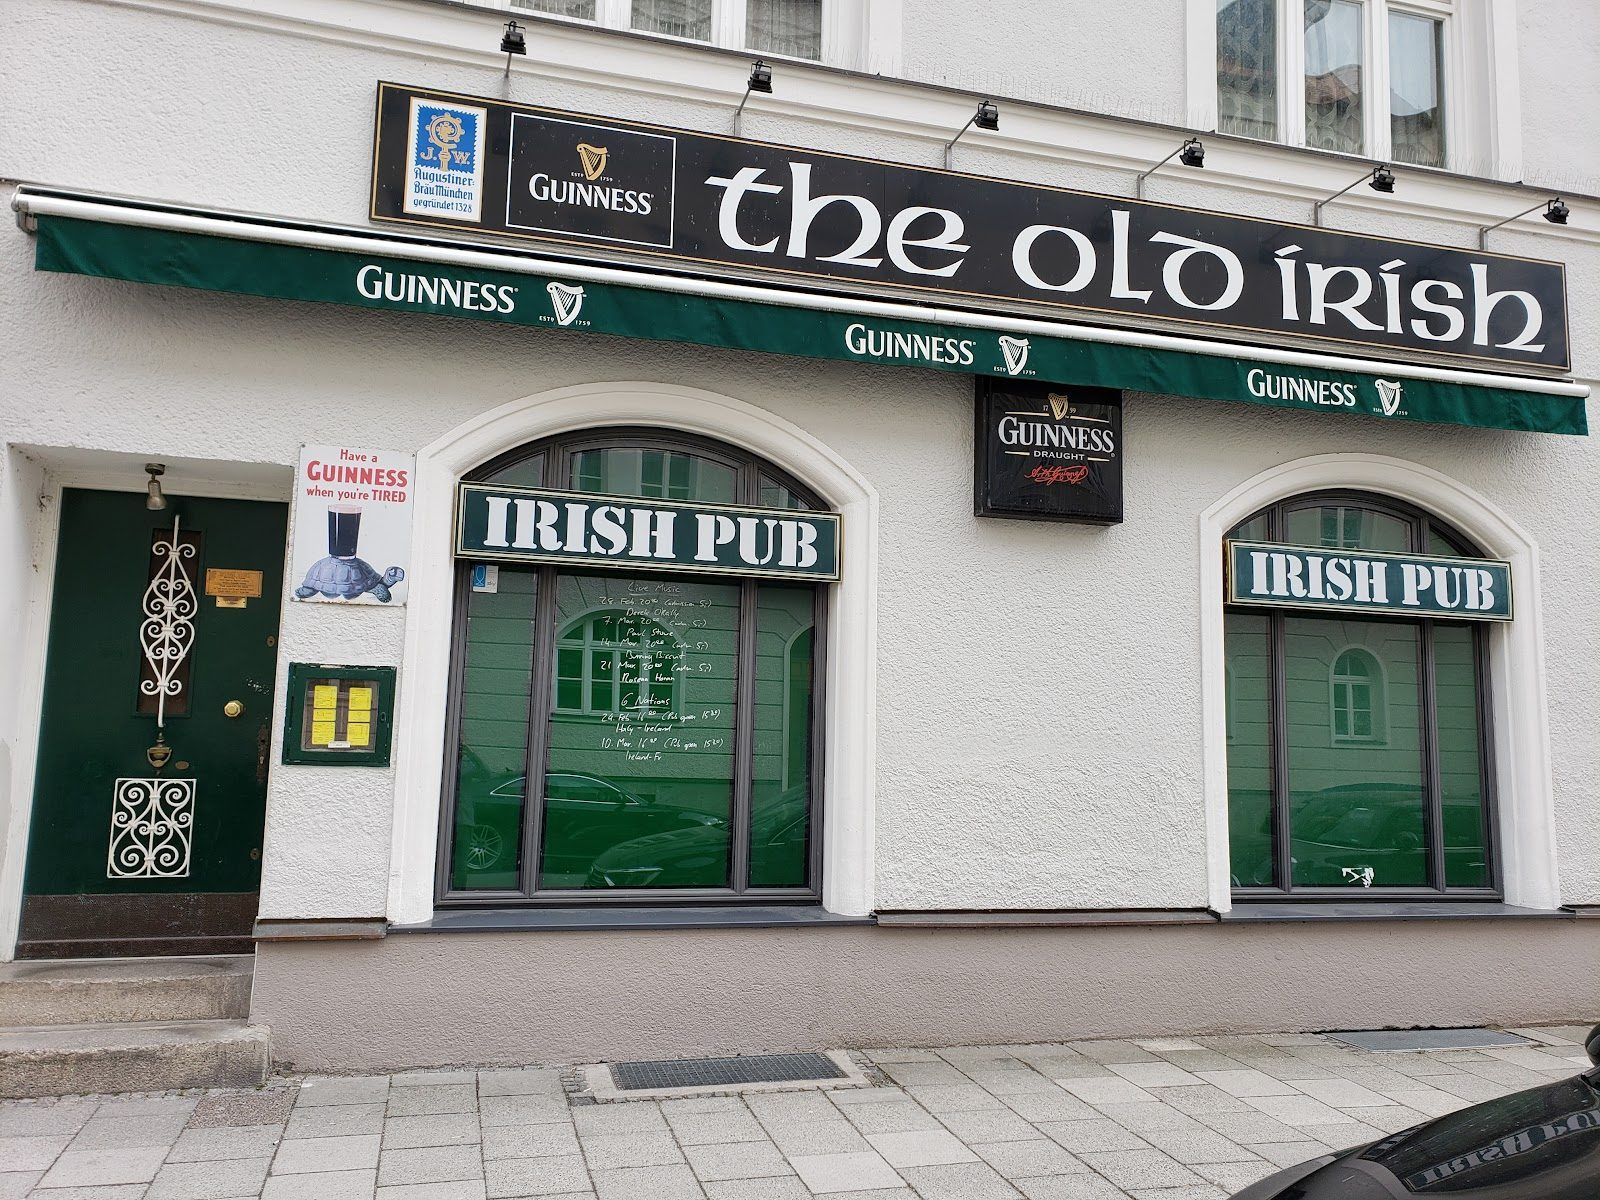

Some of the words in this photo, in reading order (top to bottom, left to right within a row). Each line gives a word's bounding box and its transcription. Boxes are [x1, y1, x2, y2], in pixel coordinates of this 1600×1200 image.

[413, 198, 455, 211] gegründet
[455, 202, 473, 214] 1328
[528, 173, 653, 216] GUINNESS
[704, 161, 969, 277] the
[1012, 209, 1243, 311] old
[356, 264, 518, 314] GUINNESS
[575, 319, 591, 327] 1759
[845, 323, 976, 365] GUINNESS
[1247, 368, 1358, 407] GUINNESS
[998, 415, 1115, 454] GUINNESS
[340, 449, 367, 462] Have
[372, 454, 378, 463] a
[1033, 450, 1085, 461] DRAUGHT
[307, 460, 408, 488] GUINNESS
[306, 485, 334, 498] when
[338, 488, 369, 501] you're
[372, 489, 407, 503] TIRED
[483, 496, 677, 560] IRISH
[694, 513, 819, 569] PUB
[628, 582, 649, 592] Live
[655, 584, 681, 593] Music
[1250, 551, 1389, 604] IRISH
[1400, 563, 1495, 610] PUB
[621, 692, 634, 707] 6
[634, 693, 671, 706] Nations
[643, 722, 673, 733] Ireland
